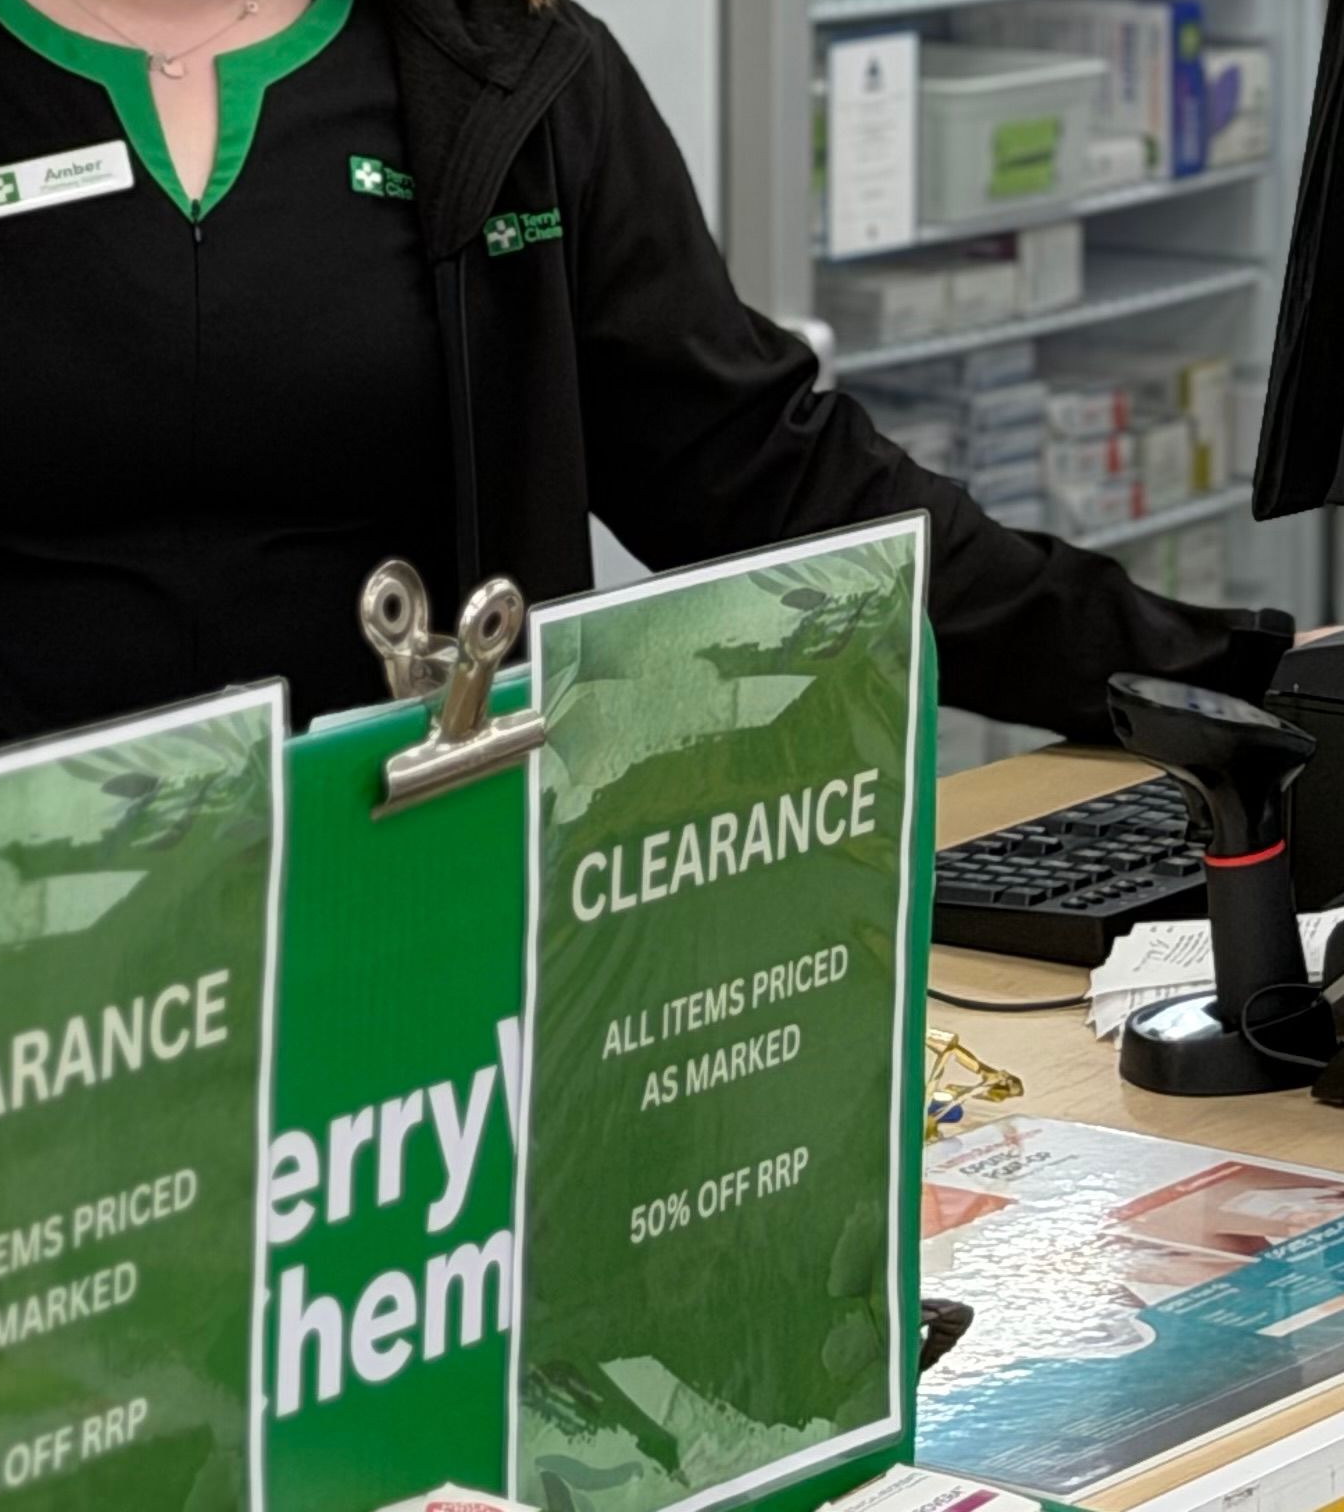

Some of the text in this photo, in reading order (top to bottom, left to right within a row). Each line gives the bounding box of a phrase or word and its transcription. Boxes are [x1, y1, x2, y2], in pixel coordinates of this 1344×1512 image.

[44, 159, 103, 183] Amber
[570, 768, 880, 922] CLEARANCE
[602, 944, 850, 1061] ALL ITEMS PRICED
[641, 1024, 801, 1111] AS MARKED
[72, 1169, 199, 1248] PRICED
[630, 1146, 809, 1244] 50% OFF RRP
[259, 1226, 513, 1420] hem
[4, 1426, 71, 1485] OFF
[80, 1398, 149, 1461] RRP
